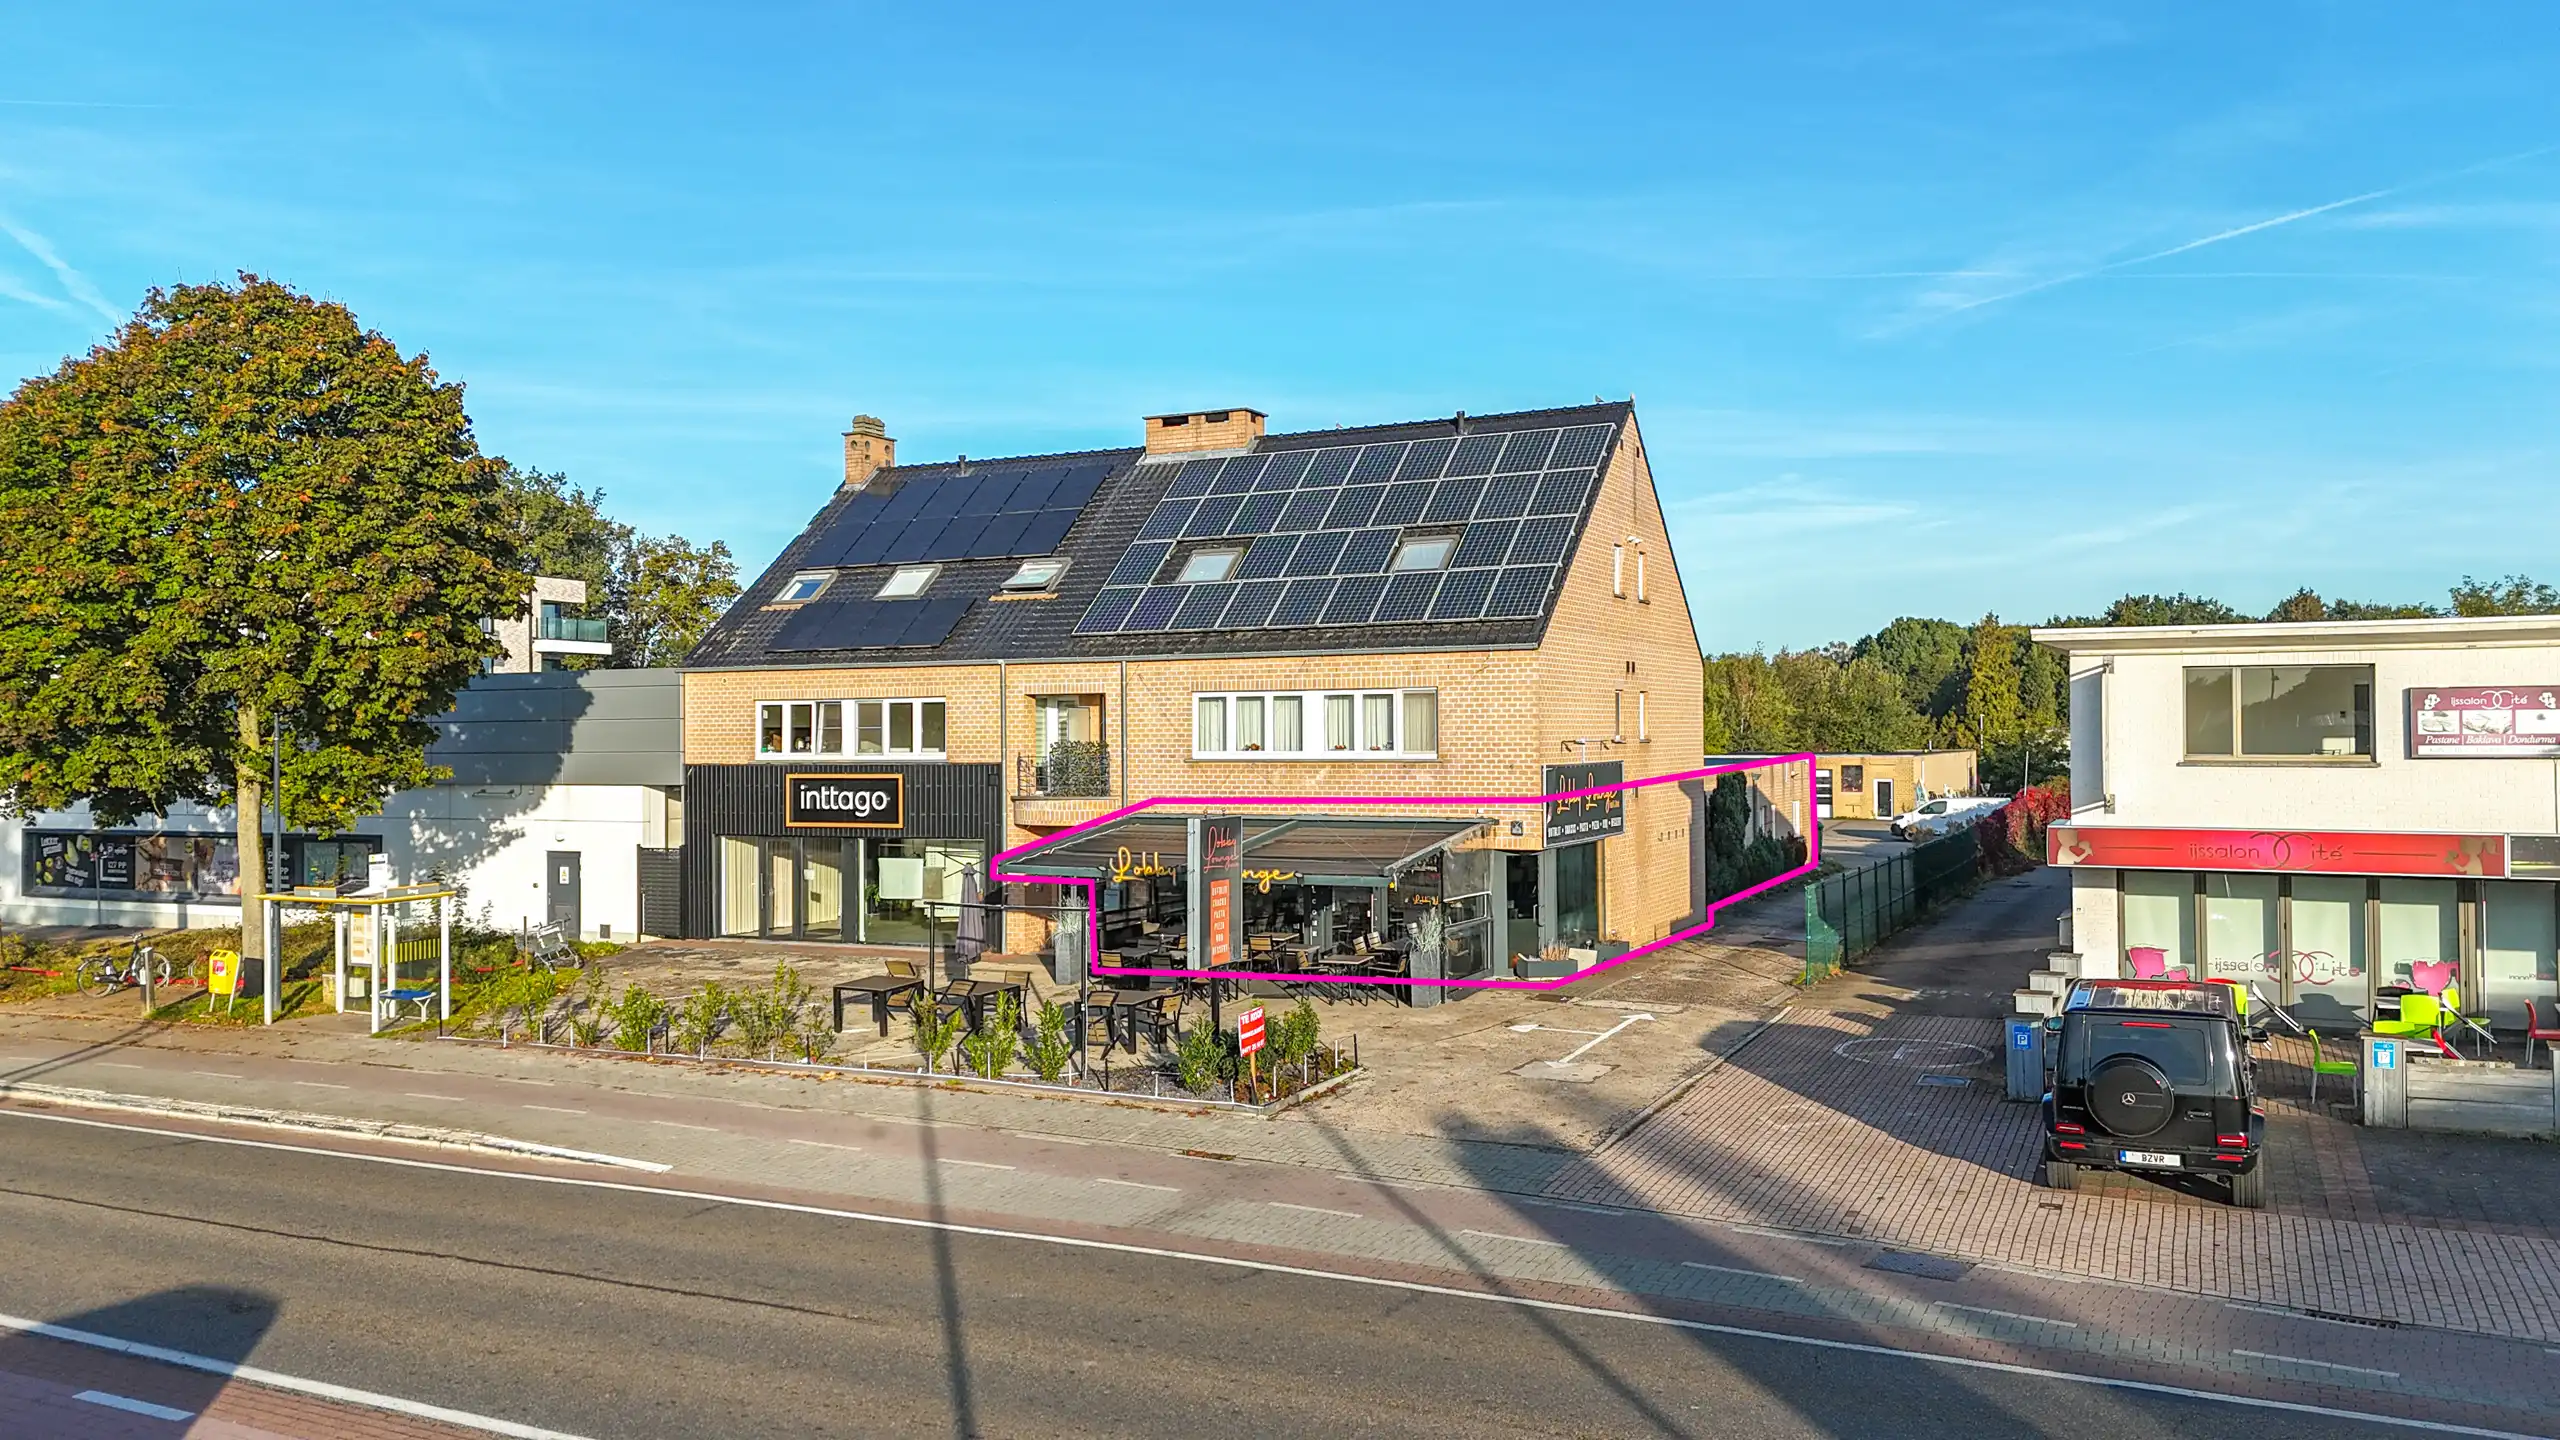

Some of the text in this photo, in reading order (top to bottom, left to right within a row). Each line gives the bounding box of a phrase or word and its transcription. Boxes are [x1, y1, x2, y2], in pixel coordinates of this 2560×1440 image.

[2425, 735, 2556, 744] Pastane Baklava Dondurma
[800, 784, 888, 818] inttago
[2189, 843, 2260, 861] ijssalon
[1109, 846, 1177, 886] Lobby
[1241, 1008, 1263, 1025] TE KOOP
